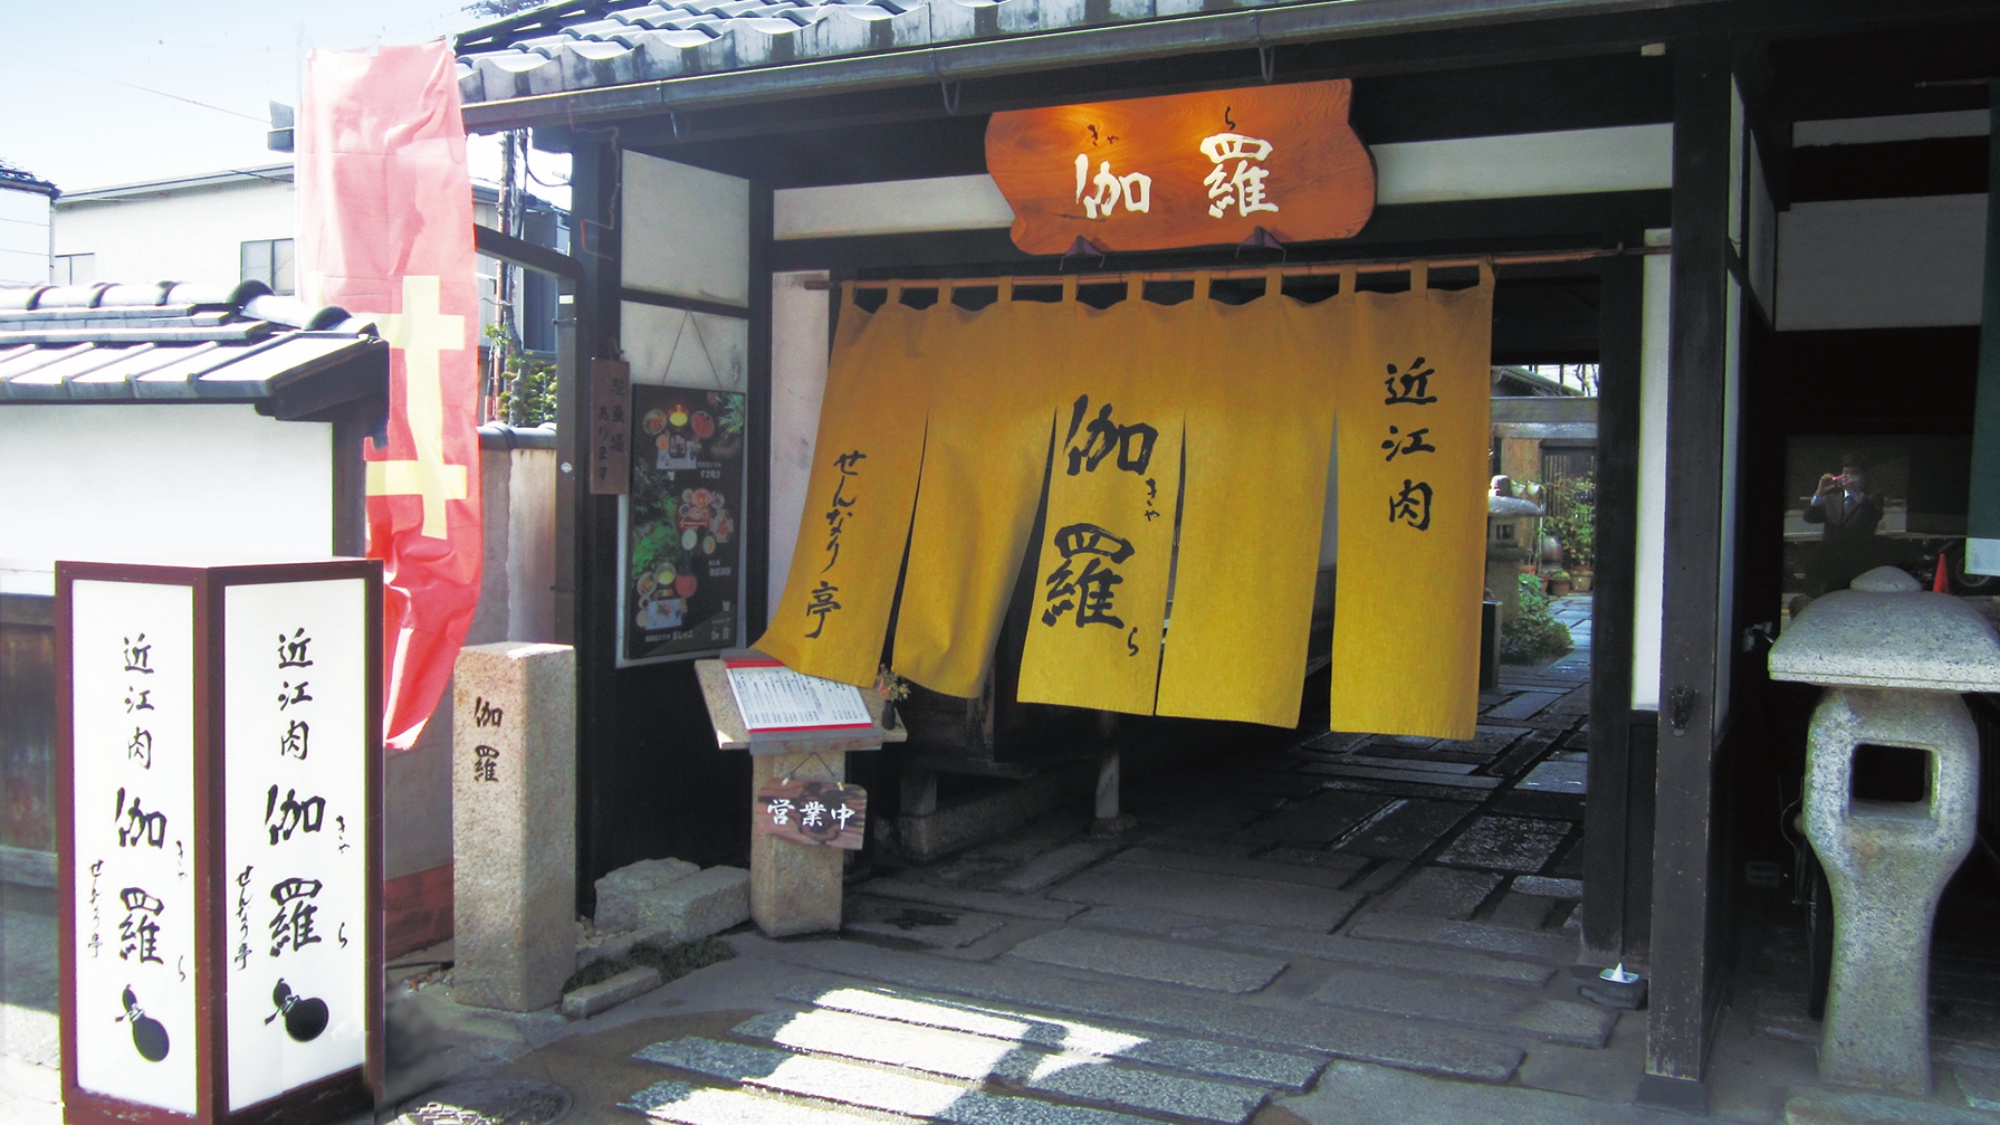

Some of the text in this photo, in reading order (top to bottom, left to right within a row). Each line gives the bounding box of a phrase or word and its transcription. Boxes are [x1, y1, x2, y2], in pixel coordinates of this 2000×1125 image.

[1074, 132, 1280, 219] 伽羅
[1041, 393, 1160, 630] 伽羅
[1381, 356, 1439, 532] 近江肉
[804, 449, 868, 639] せんなり亭
[123, 632, 155, 770] 近江肉
[277, 627, 314, 761] 近江肉
[473, 695, 504, 783] 伽羅
[114, 786, 168, 965] 伽羅
[265, 783, 327, 958] 伽羅
[766, 799, 857, 831] 営業中
[234, 864, 255, 971] せんなり亭
